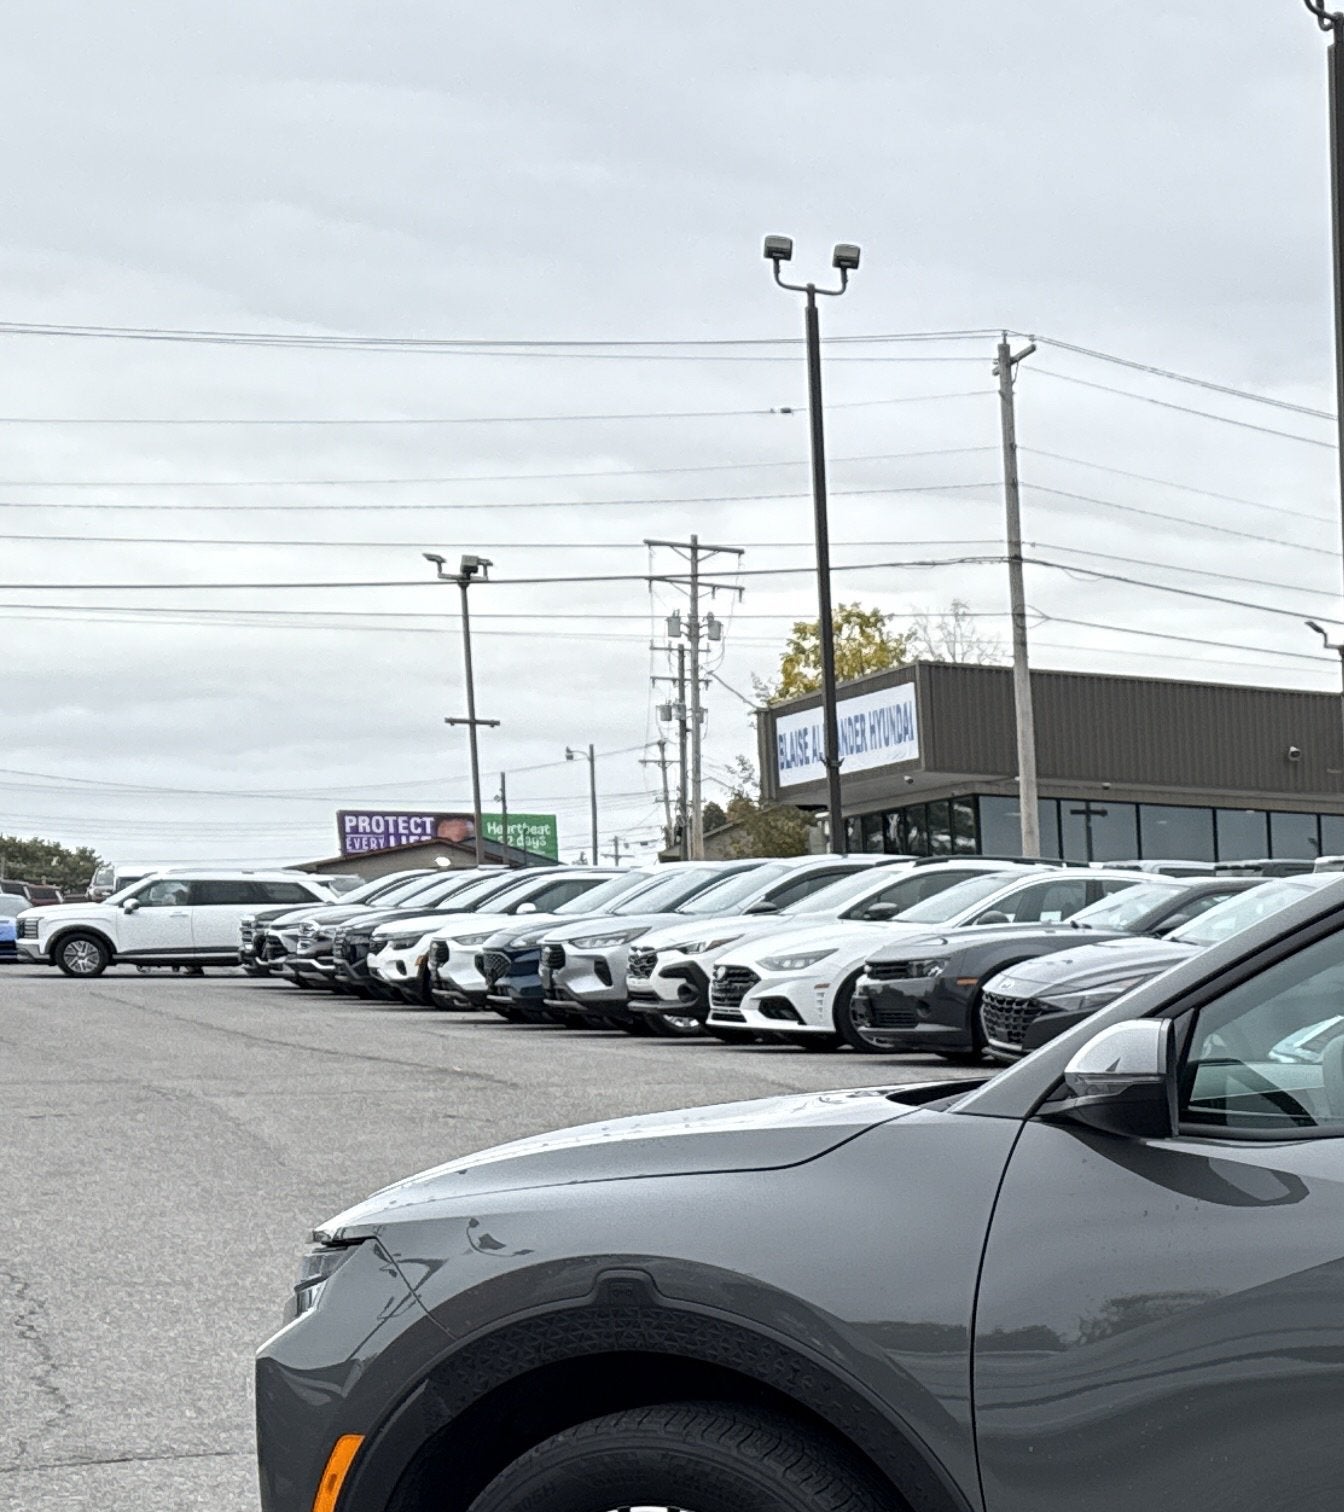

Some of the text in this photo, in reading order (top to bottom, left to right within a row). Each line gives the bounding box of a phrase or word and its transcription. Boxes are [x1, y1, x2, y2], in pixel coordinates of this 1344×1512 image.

[778, 727, 810, 770] BLAISE
[868, 701, 915, 752] HYUNDAI
[344, 815, 435, 834] PROTECT
[346, 836, 385, 850] EVERY
